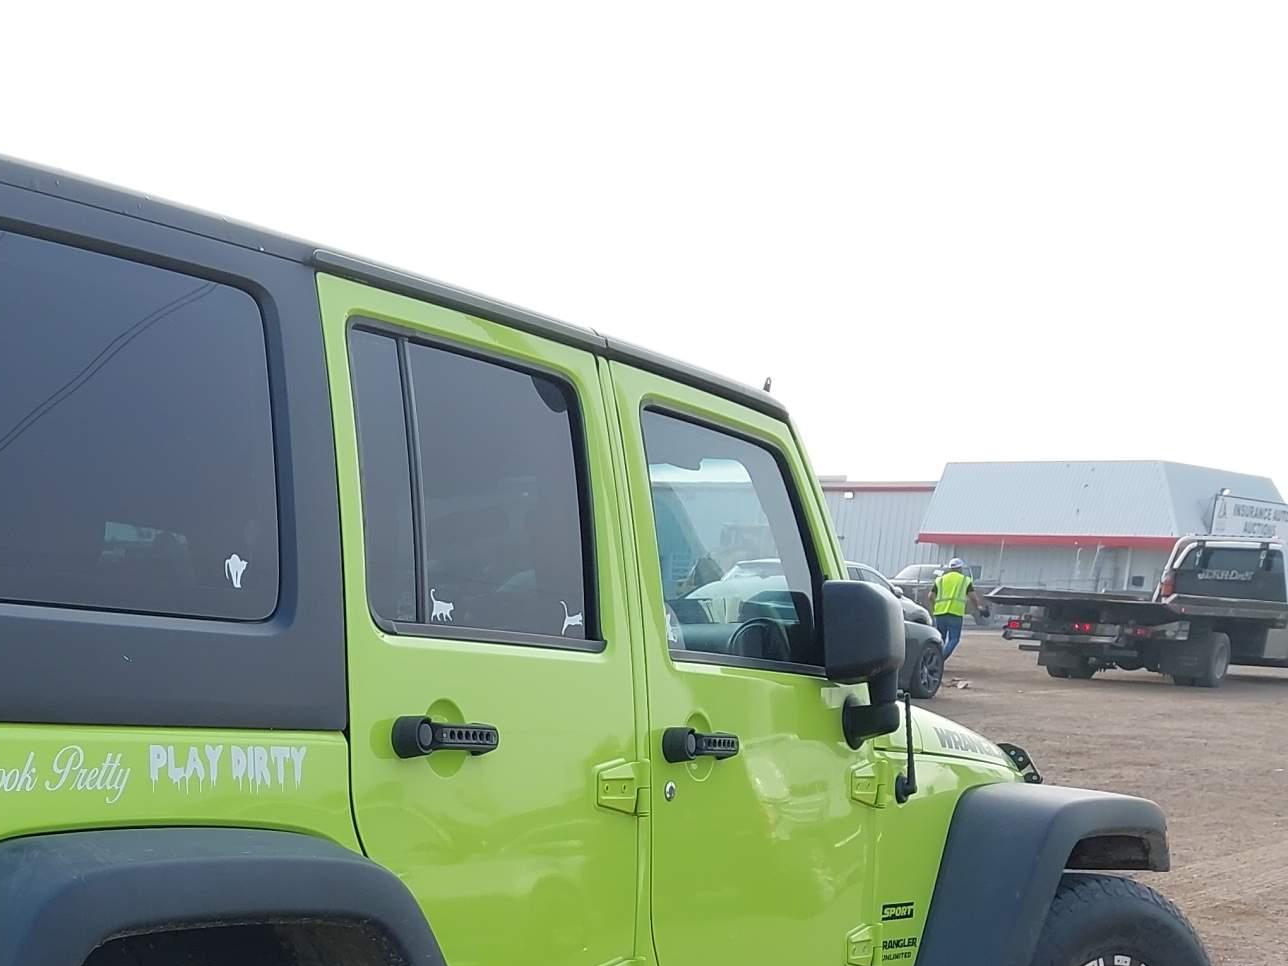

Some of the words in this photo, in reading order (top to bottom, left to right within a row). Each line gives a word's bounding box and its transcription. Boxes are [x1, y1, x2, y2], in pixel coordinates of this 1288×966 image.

[44, 744, 132, 804] Pretty
[149, 744, 224, 798] PLAY
[230, 745, 306, 796] DIRTY
[882, 905, 913, 918] SPORT
